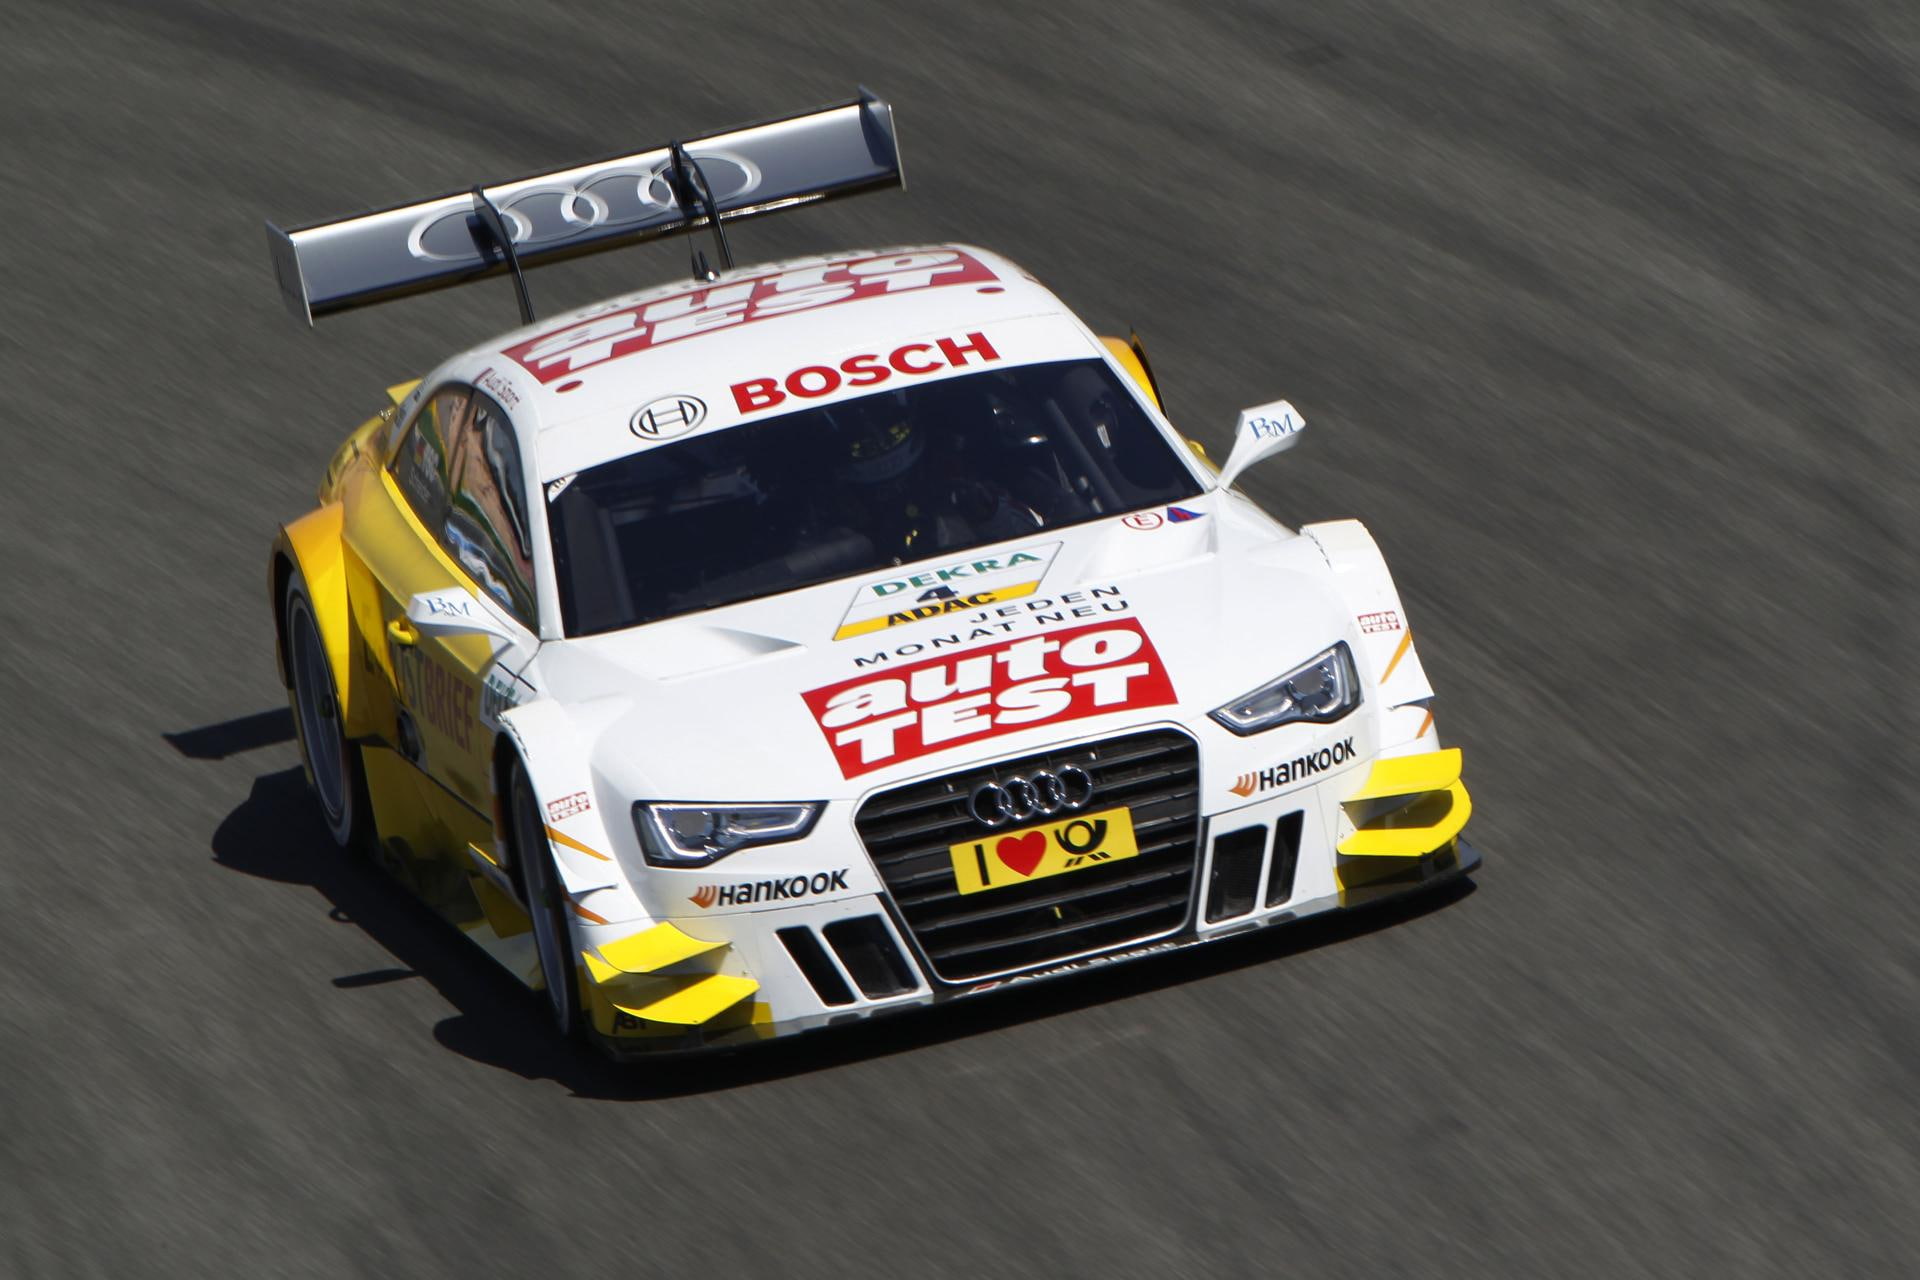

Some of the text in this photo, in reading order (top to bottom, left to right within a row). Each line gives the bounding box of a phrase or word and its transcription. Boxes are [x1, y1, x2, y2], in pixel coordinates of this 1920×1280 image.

[524, 248, 961, 362] auto
[538, 263, 965, 370] TEST
[730, 332, 1001, 415] BOSCH
[872, 552, 1042, 597] DEKRA
[916, 584, 959, 602] 4
[970, 585, 1121, 624] JEDEN
[853, 600, 1130, 668] MONAT NEU
[887, 592, 999, 627] ADAC
[821, 629, 1143, 728] auto
[835, 662, 1150, 765] TEST
[975, 844, 991, 887] I
